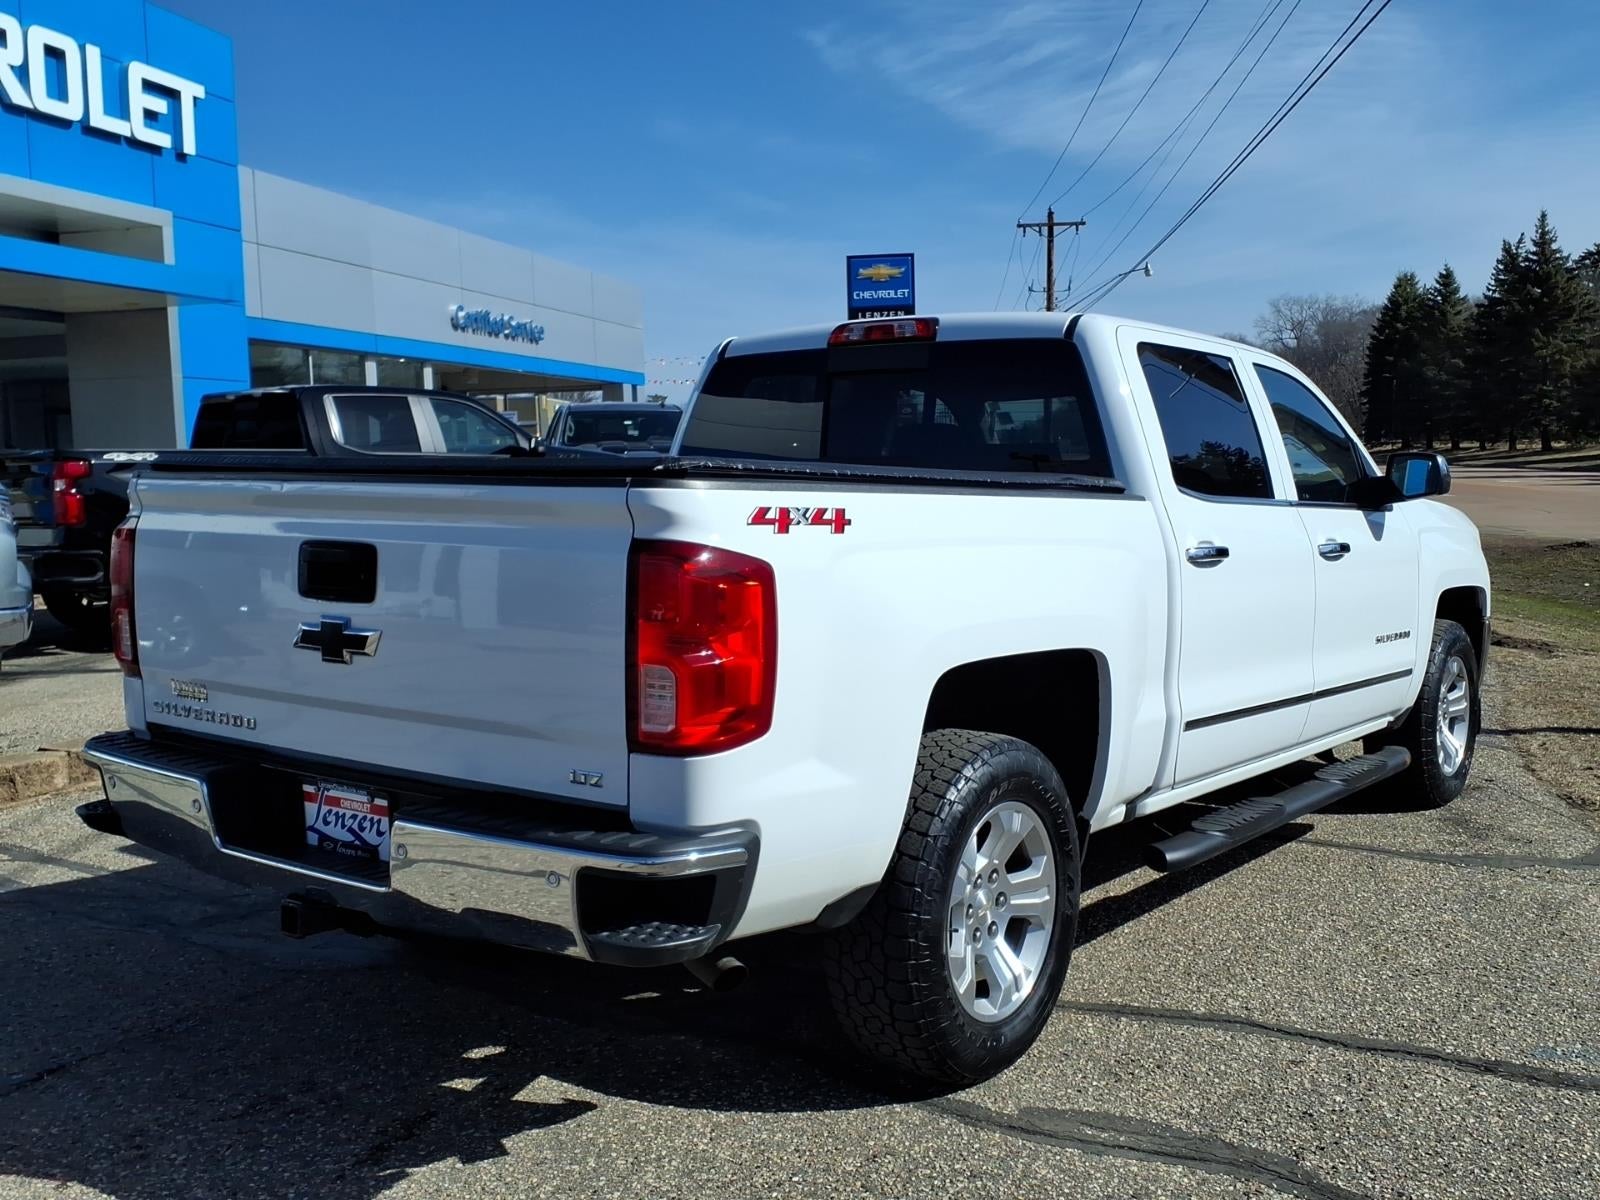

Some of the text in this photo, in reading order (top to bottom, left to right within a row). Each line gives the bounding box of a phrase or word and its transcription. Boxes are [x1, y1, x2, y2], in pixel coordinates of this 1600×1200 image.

[853, 288, 909, 300] CHEVROLET
[857, 310, 905, 320] LENZEN
[1375, 630, 1411, 645] SILVERADO
[152, 701, 257, 731] SILVERADO
[339, 798, 371, 814] CHEVROLET
[306, 786, 388, 848] Lenzen
